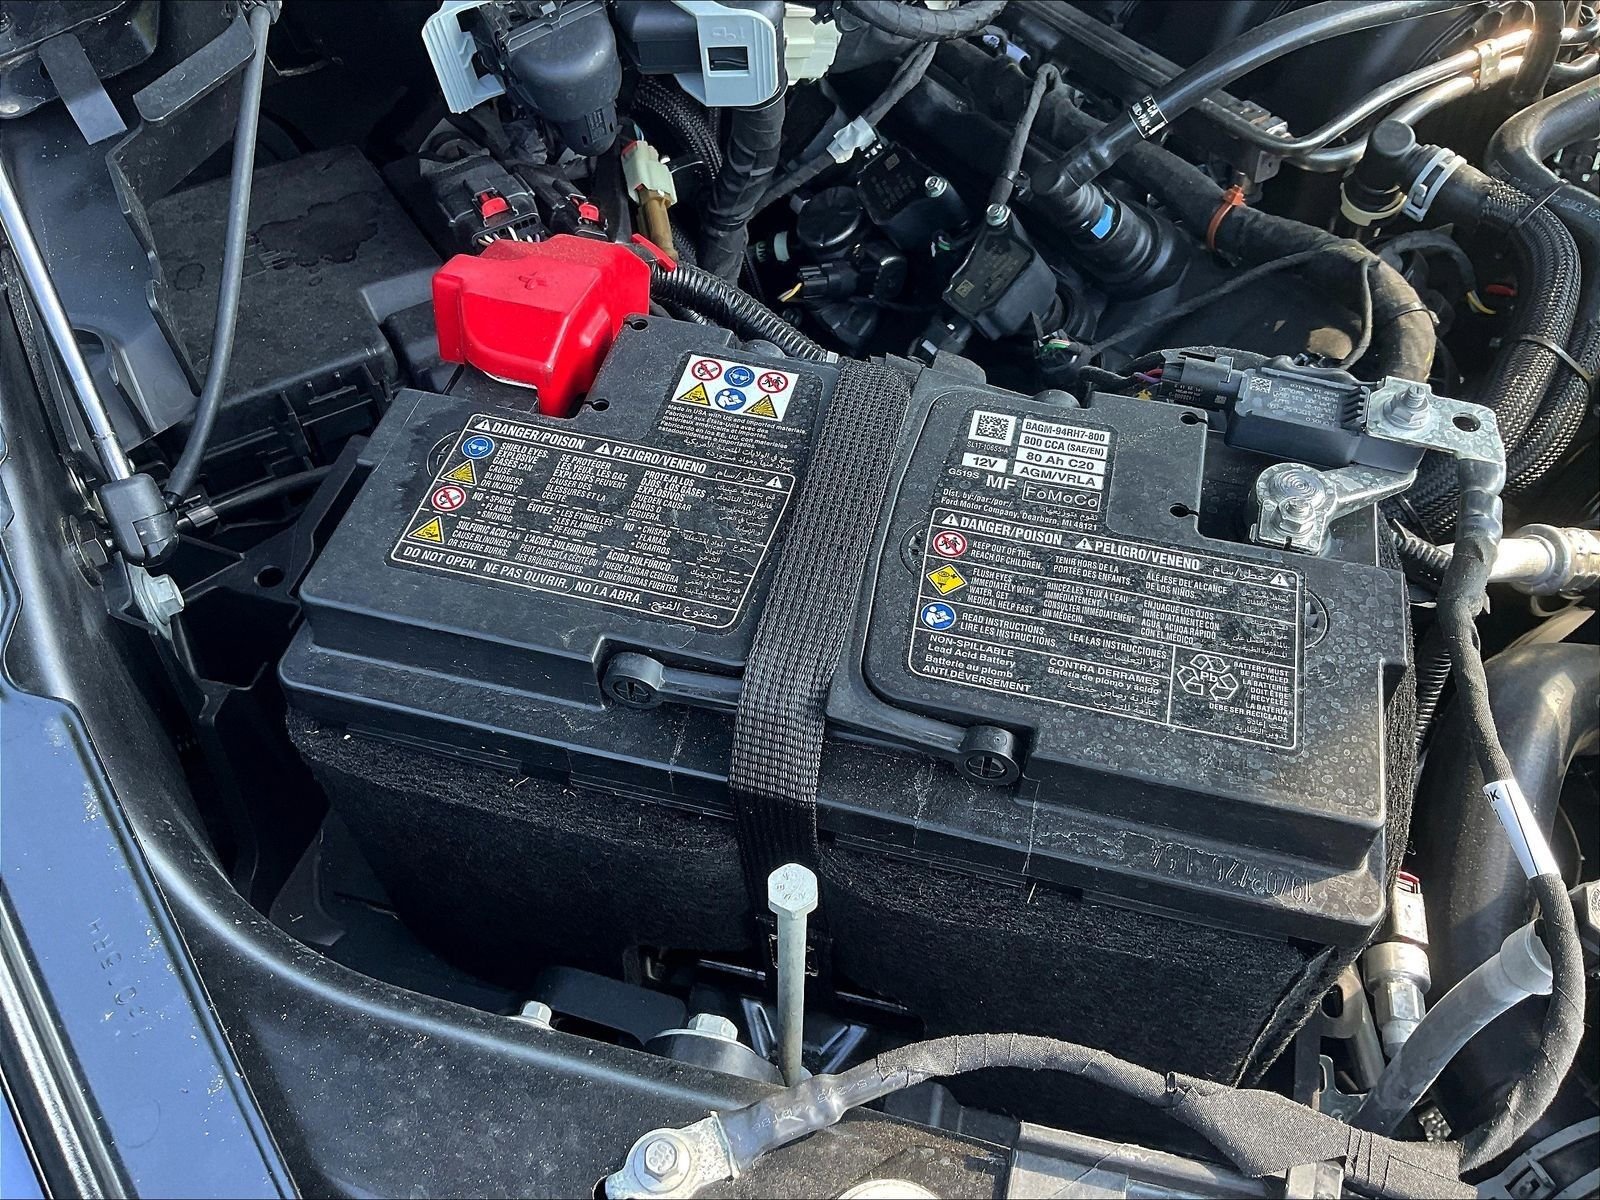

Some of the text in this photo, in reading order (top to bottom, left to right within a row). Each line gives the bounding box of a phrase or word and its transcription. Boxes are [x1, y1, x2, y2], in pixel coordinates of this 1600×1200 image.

[490, 422, 586, 449] DANGER/POISON
[1025, 421, 1104, 442] BAGM-94RH7-800
[499, 442, 551, 458] SHIELD EYES.
[1023, 436, 1104, 457] 800 CCA (SAE/EN)
[491, 457, 534, 471] GASES CAN
[495, 449, 539, 464] EXPLOSIVE
[559, 453, 612, 470] SE PROTÉGER
[611, 446, 708, 473] PELIGRO/VENENO
[972, 456, 997, 468] 12V
[1026, 451, 1094, 470] 80 Ah C20
[483, 471, 524, 485] BLINDNESS
[487, 464, 512, 475] CAUSE
[551, 468, 627, 490] EXPLOSIFS PEUVENT
[555, 461, 572, 470] LES
[595, 468, 612, 478] LES
[610, 471, 628, 481] GAZ
[643, 470, 695, 486] PROTEJA LOS
[948, 467, 979, 478] G519S
[1019, 465, 1095, 487] AGM/VRLA
[479, 479, 520, 493] OR INJURY.
[548, 476, 592, 490] CAUSER DES
[662, 482, 680, 492] LOS
[678, 485, 707, 498] GASES
[985, 474, 1016, 491] MF
[471, 492, 517, 506] NO SPARKS
[544, 483, 607, 502] BLESSURES ET LA
[632, 493, 692, 511] PUEDEN CAUSAR
[635, 485, 686, 501] EXPLOSIVOS
[942, 488, 960, 498] Dist.
[1026, 486, 1097, 508] FoMoCo
[484, 503, 513, 514] FLAMES
[526, 502, 614, 526] ÉVITEZ LES ÉTINCELLES
[626, 508, 663, 521] CEGUERA.
[629, 499, 656, 512] DAÑOS
[940, 497, 958, 506] Ford
[959, 500, 982, 511] Motor
[983, 505, 1020, 517] Company,
[1022, 512, 1059, 525] Dearborn,
[1061, 519, 1072, 527] MI
[1073, 521, 1096, 531] 48121
[480, 510, 513, 523] SMOKING
[555, 517, 604, 533] LES FLAMMES
[450, 529, 512, 548] CAUSE BLINDNESS
[455, 520, 521, 540] SULFURIC ACID CAN
[551, 524, 587, 538] DE FUMER
[622, 522, 672, 538] NO CHISPAS
[637, 533, 667, 545] FLAMAS
[959, 516, 1062, 545] DANGER/POISON
[446, 538, 510, 557] OR SEVERE BURNS.
[523, 534, 598, 556] L'ACIDE SULFURIQUE
[634, 541, 671, 555] CIGARROS
[972, 540, 1030, 558] KEEP OUT OF THE
[605, 549, 673, 571] ÁCIDO SULFÚRICO
[970, 549, 1042, 569] REACH OF CHILDREN.
[1095, 540, 1200, 570] PELIGRO/VENENO
[402, 546, 645, 604] DO NOT OPEN. NE PAS OUVRIR. NO LA ABRA.
[597, 569, 680, 593] O QUEMADURAS FUERTES.
[601, 561, 680, 583] PUEDE CAUSAR CEGUERA
[962, 612, 1047, 636] READ INSTRUCTIONS.
[960, 621, 1058, 647] LIRE LES INSTRUCTIONS.
[927, 643, 1015, 667] Lead Acid Battery
[929, 634, 1014, 657] NON-SPILLABLE
[1068, 632, 1168, 659] LEA LAS INSTRUCCIONES.
[925, 654, 1013, 678] Batterie au plomb
[1049, 657, 1159, 686] CONTRA DERRAMES
[1234, 661, 1288, 676] BATTERY MUST
[923, 664, 1031, 693] ANTI DÉVERSEMENT
[1047, 666, 1079, 679] Batería
[1081, 673, 1092, 681] de
[1095, 676, 1124, 688] plomo
[1133, 683, 1158, 695] ácido
[1200, 670, 1217, 682] Pb
[1251, 671, 1288, 683] RECYCLED
